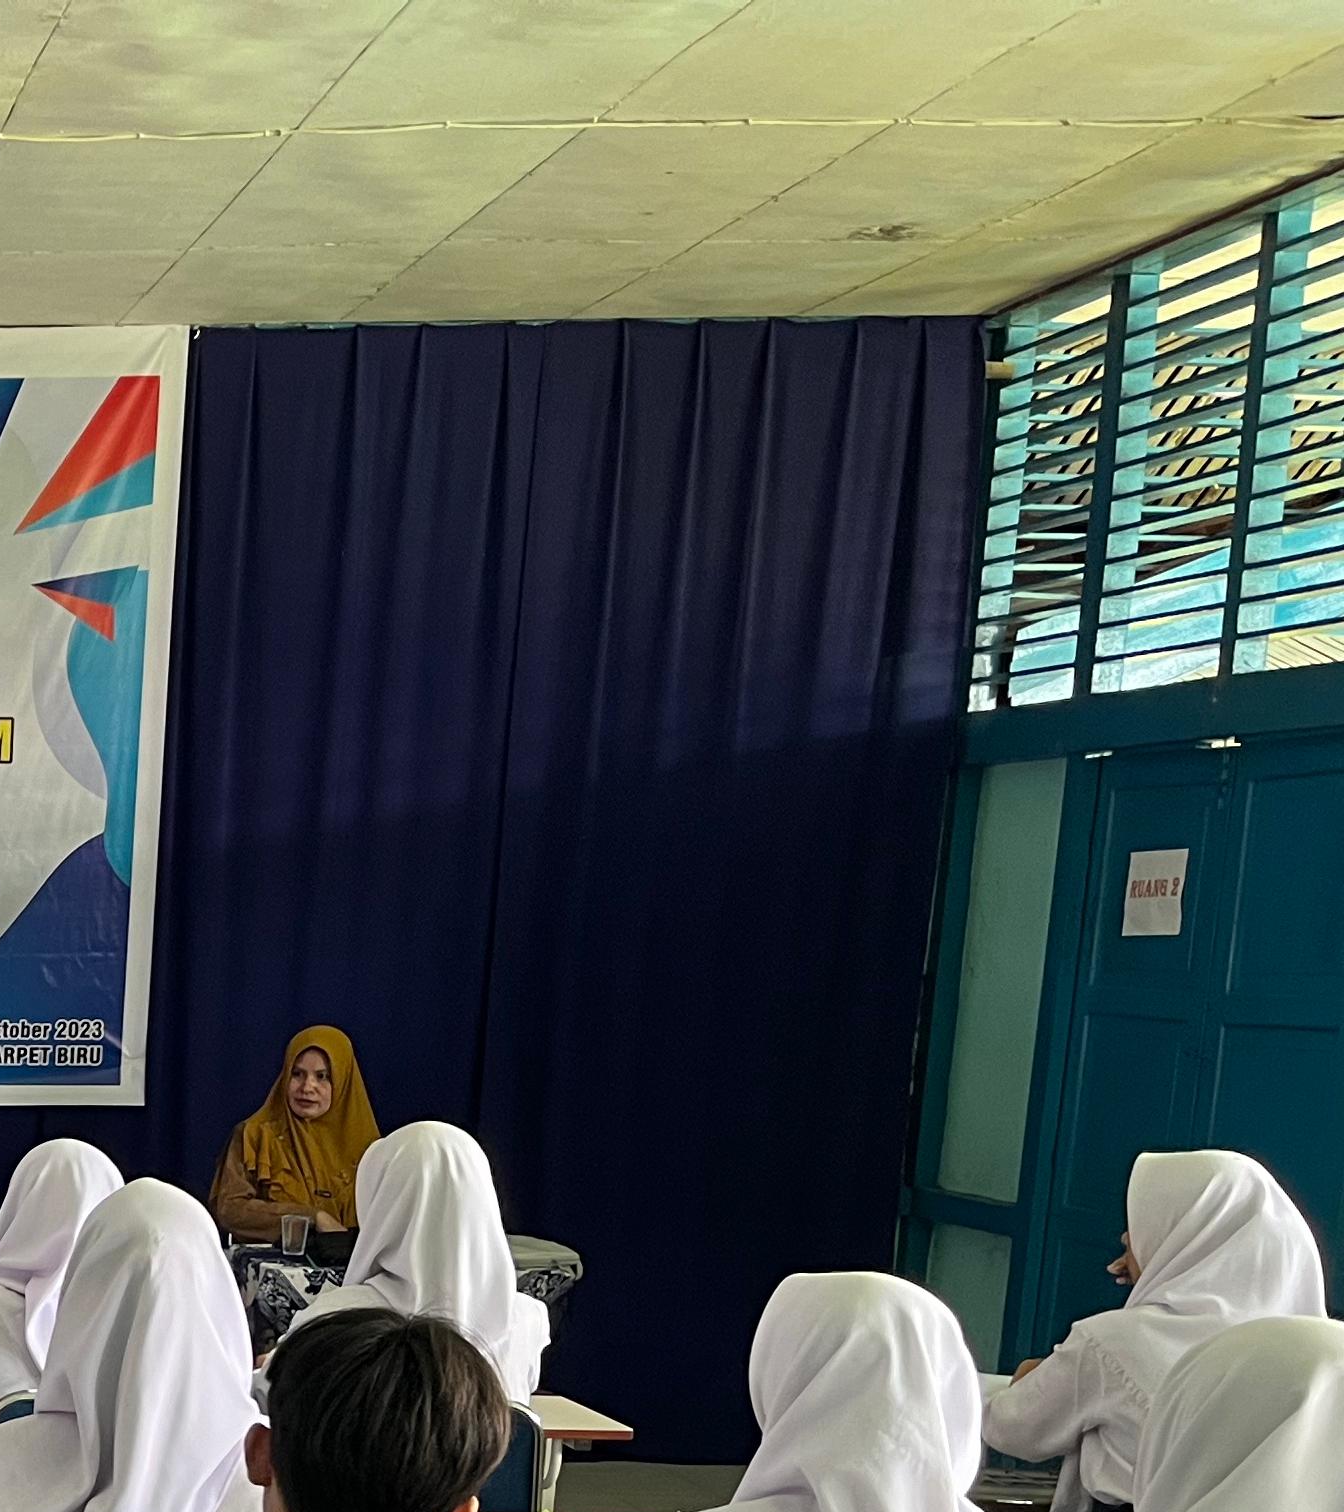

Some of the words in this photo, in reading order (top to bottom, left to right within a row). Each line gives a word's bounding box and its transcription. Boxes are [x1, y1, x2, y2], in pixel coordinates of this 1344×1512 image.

[1129, 879, 1168, 898] RUANG
[1170, 877, 1180, 896] 2
[54, 1019, 104, 1040] 2023
[56, 1045, 102, 1066] BIRU
